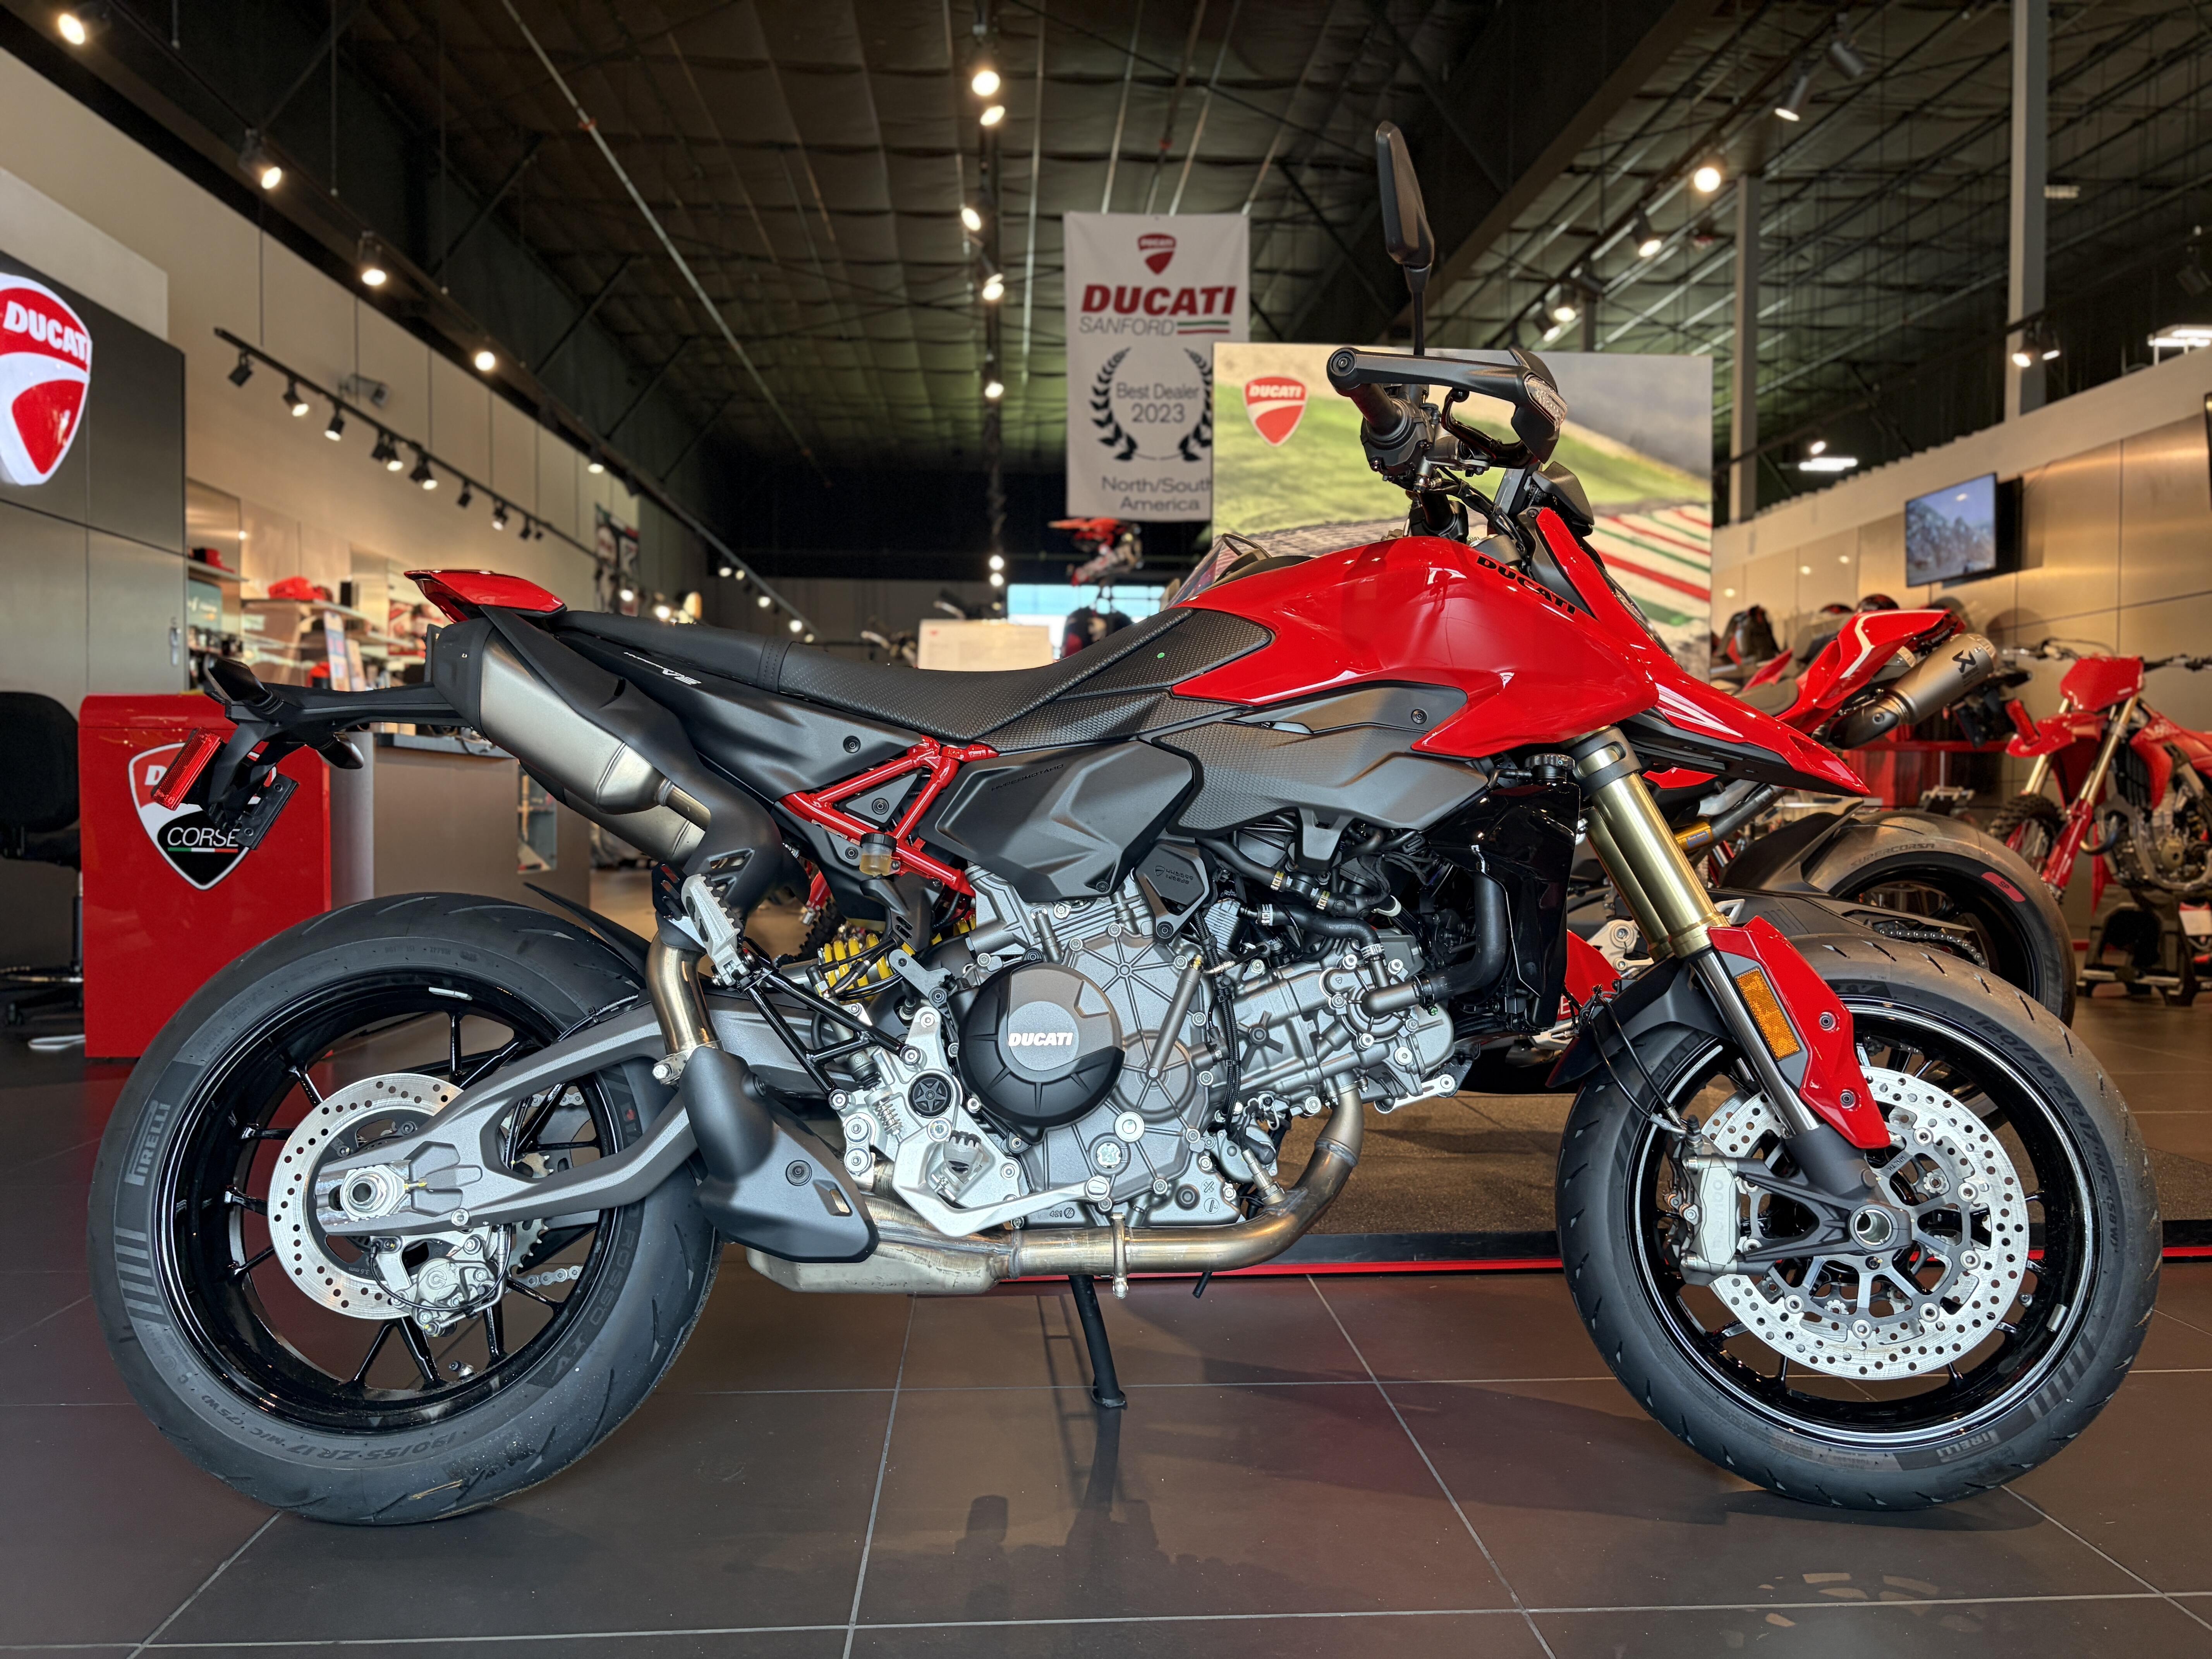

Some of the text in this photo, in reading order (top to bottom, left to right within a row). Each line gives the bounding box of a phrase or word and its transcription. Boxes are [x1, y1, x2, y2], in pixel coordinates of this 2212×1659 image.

[1082, 284, 1236, 316] DUCATI
[1079, 316, 1175, 336] SANFORD
[1116, 382, 1199, 400] Best Dealer
[1249, 384, 1302, 398] DUCATI
[1132, 403, 1185, 423] 2023
[1120, 495, 1200, 512] America
[1475, 555, 1577, 616] DUCATI
[167, 827, 240, 847] CORSE
[1850, 842, 1936, 867] SUPERCORSA
[1998, 881, 2010, 889] SP
[1008, 1032, 1073, 1046] DUCATI
[1975, 1020, 2054, 1079] 120/70
[2054, 1086, 2085, 1117] ZR
[124, 1099, 171, 1187] PIRELLI
[589, 1229, 636, 1326] ROSSO
[201, 1395, 244, 1425] (75W)
[286, 1444, 317, 1455] 17
[317, 1447, 360, 1460] ZR
[363, 1431, 457, 1460] 190/55
[1936, 1429, 2002, 1463] PIRELLI
